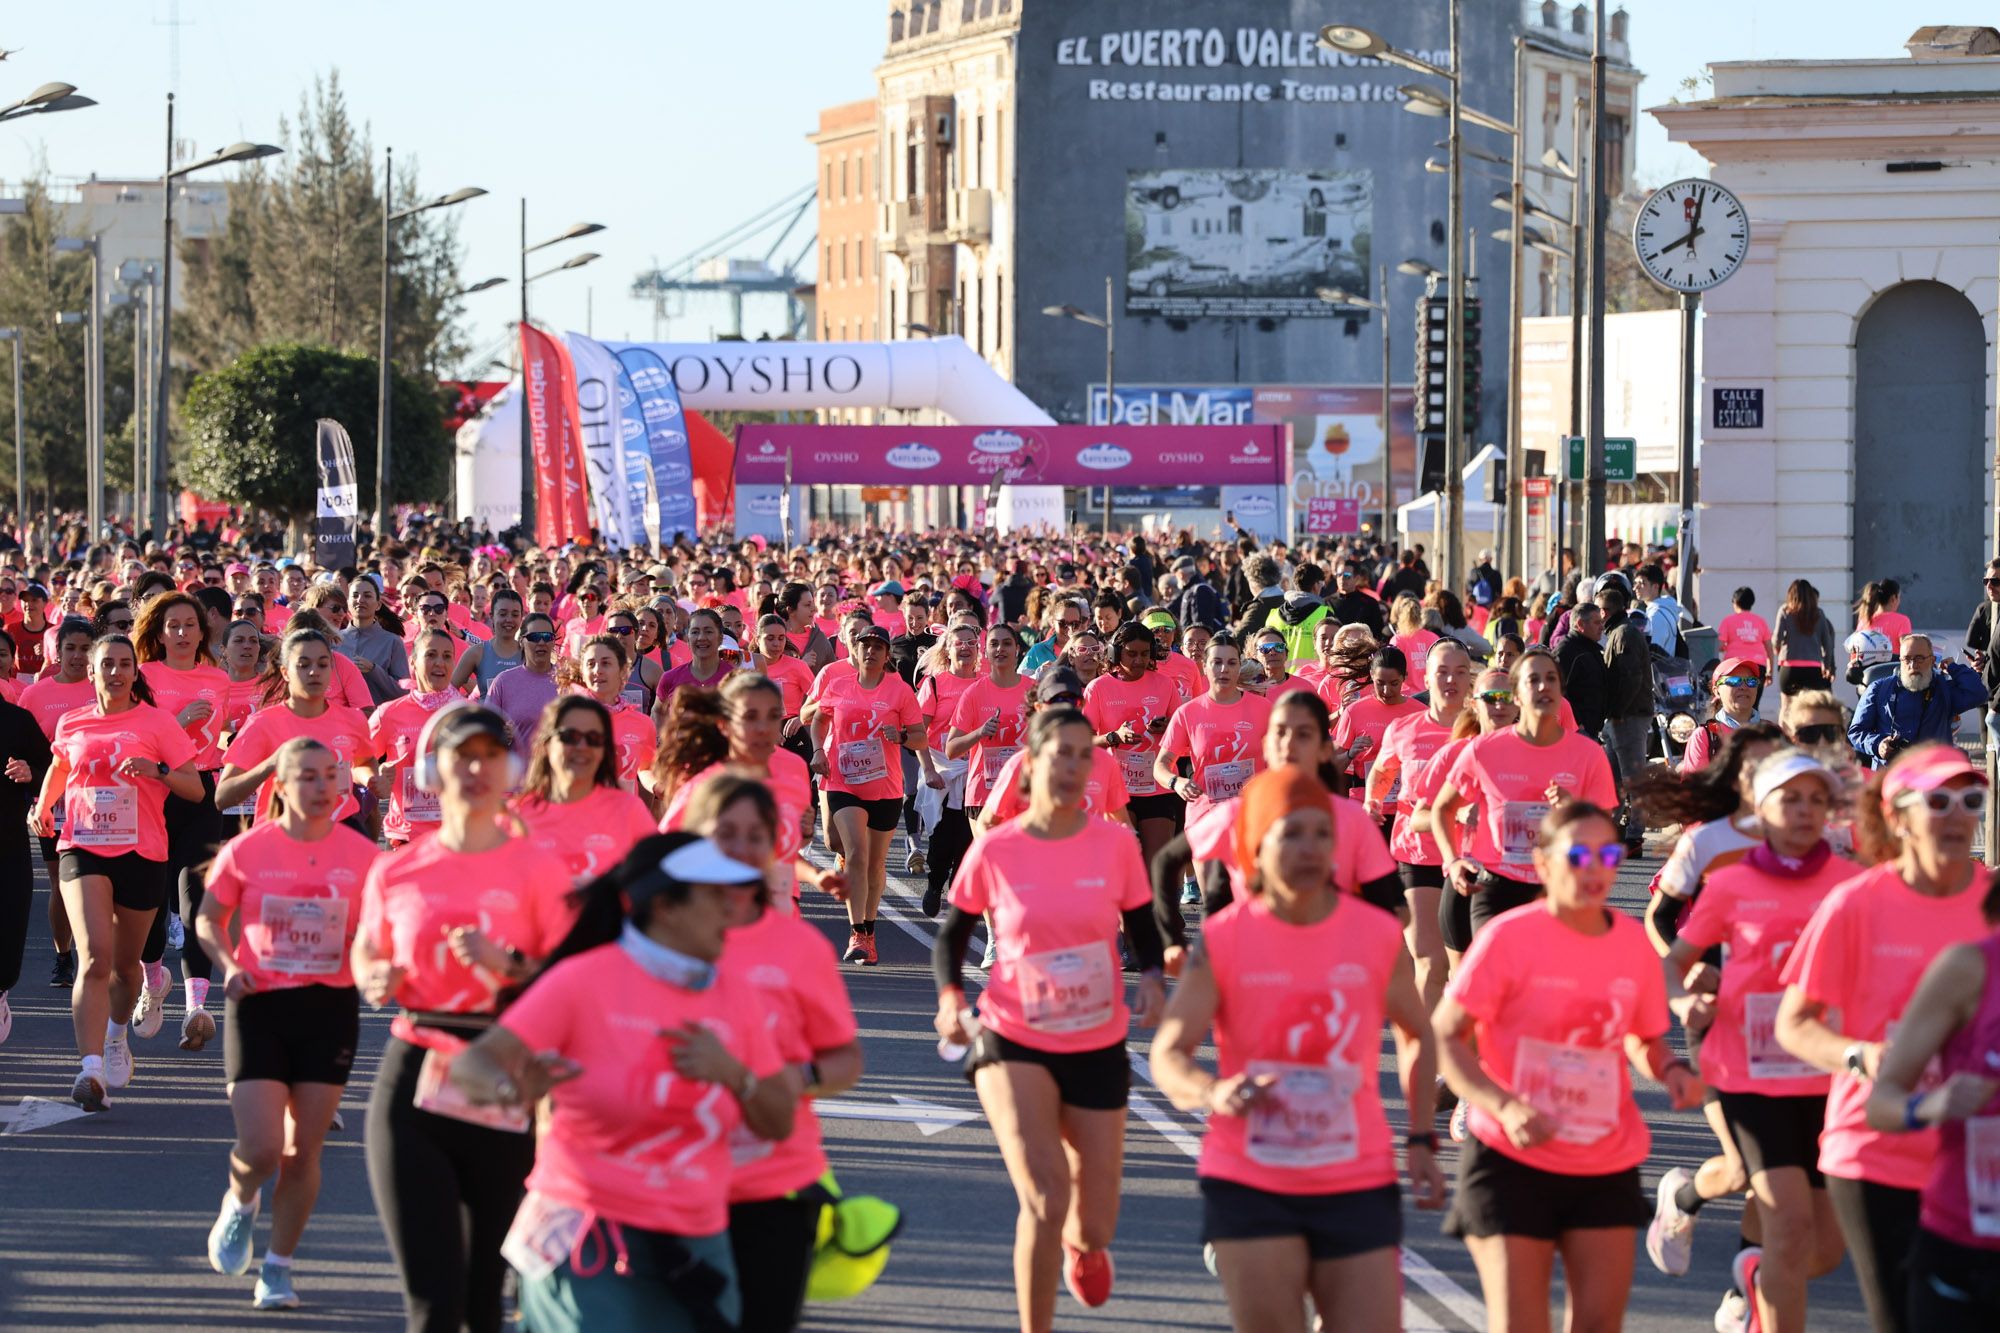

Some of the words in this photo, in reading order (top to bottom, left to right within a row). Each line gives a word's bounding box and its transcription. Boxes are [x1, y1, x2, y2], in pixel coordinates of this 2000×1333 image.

[1057, 37, 1093, 65] EL
[1101, 28, 1225, 67] PUERTO
[1089, 79, 1271, 101] Restaurante
[1281, 79, 1409, 101] Tematico
[671, 355, 862, 394] OYSHO
[1721, 390, 1757, 400] CALLE
[1093, 392, 1159, 426] Del
[1171, 392, 1252, 426] Mar
[1718, 410, 1757, 426] ESTACION
[814, 453, 859, 463] OYSHO
[1158, 452, 1204, 464] OYSHO
[1230, 455, 1272, 465] Santander
[1311, 501, 1336, 511] SUB
[853, 758, 872, 768] 016
[1127, 770, 1145, 778] 016
[93, 812, 117, 823] 016
[289, 932, 321, 945] 016
